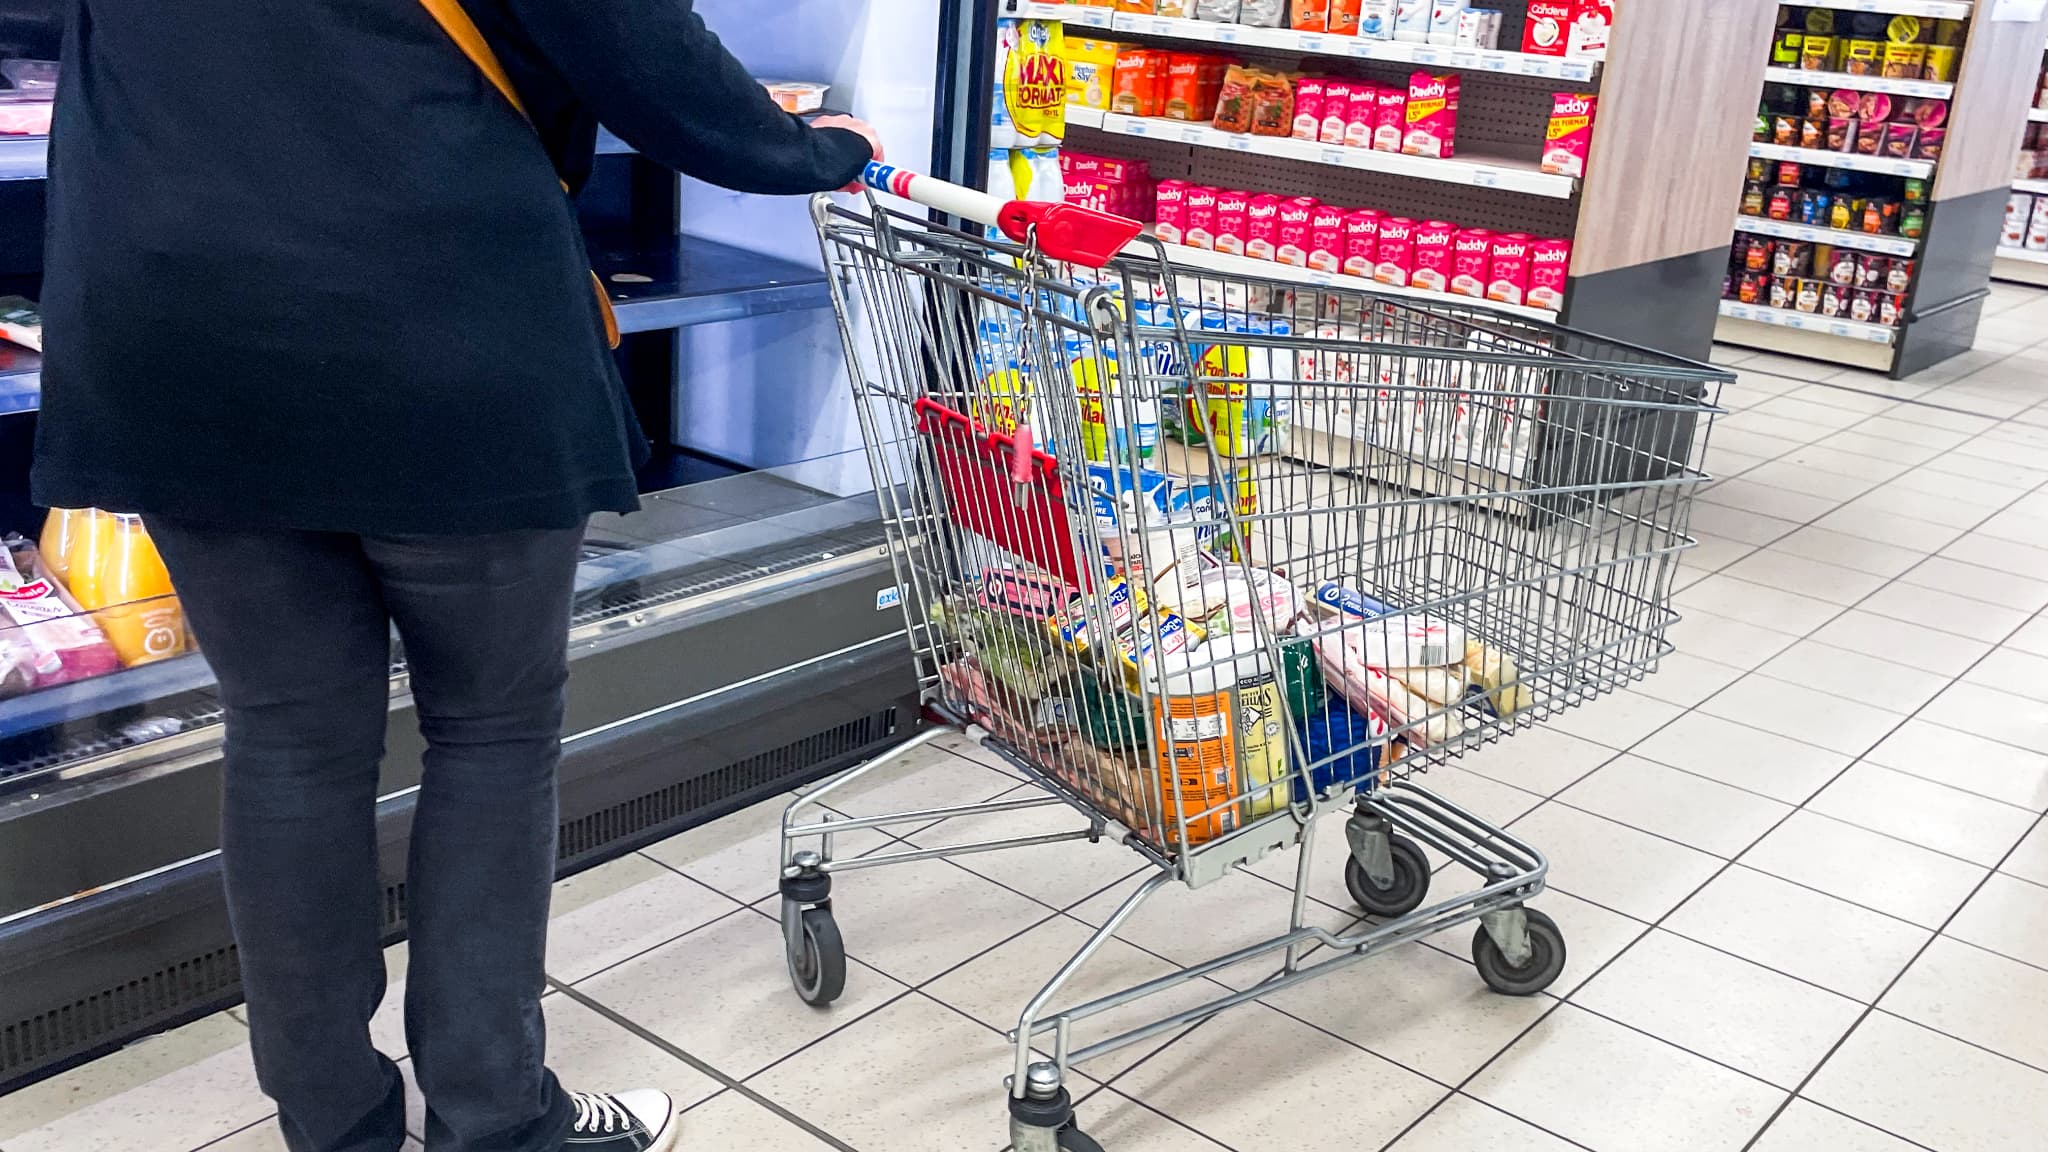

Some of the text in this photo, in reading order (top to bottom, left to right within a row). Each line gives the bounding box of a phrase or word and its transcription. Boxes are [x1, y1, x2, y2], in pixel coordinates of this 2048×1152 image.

[1020, 55, 1064, 86] MAXI
[1409, 82, 1446, 98] Daddy
[1062, 181, 1093, 197] Daddy
[1156, 189, 1182, 202] Daddy
[1188, 194, 1215, 208] Daddy
[1217, 199, 1246, 213] Daddy
[1416, 231, 1449, 246] Daddy
[1456, 238, 1488, 254] Daddy
[1493, 242, 1526, 258] Daddy
[1534, 248, 1567, 263] Daddy
